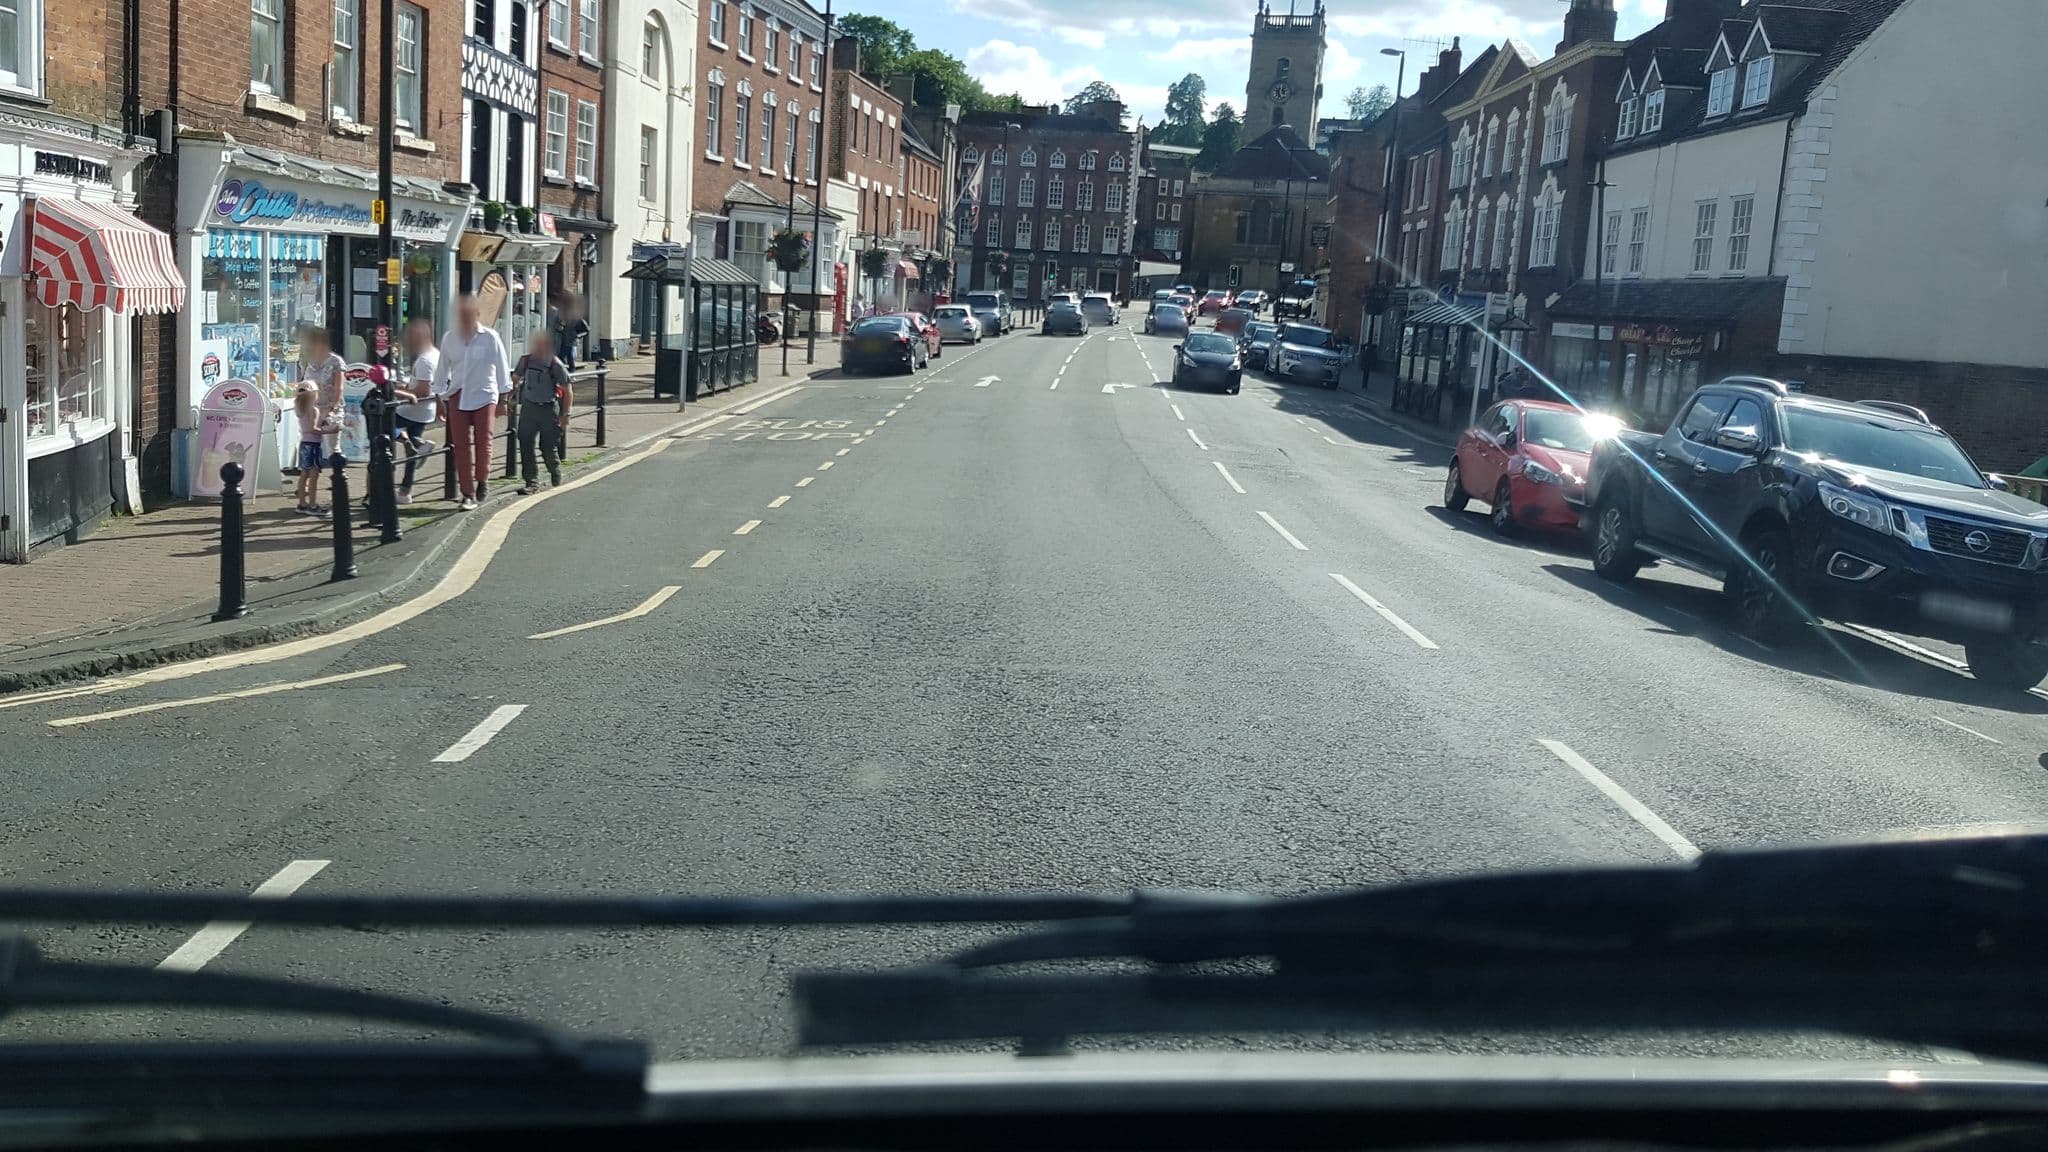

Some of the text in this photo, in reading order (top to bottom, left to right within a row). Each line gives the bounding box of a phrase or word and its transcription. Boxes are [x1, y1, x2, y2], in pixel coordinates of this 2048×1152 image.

[209, 236, 224, 251] Ice
[727, 420, 853, 430] BUS
[696, 432, 861, 441] STOP
